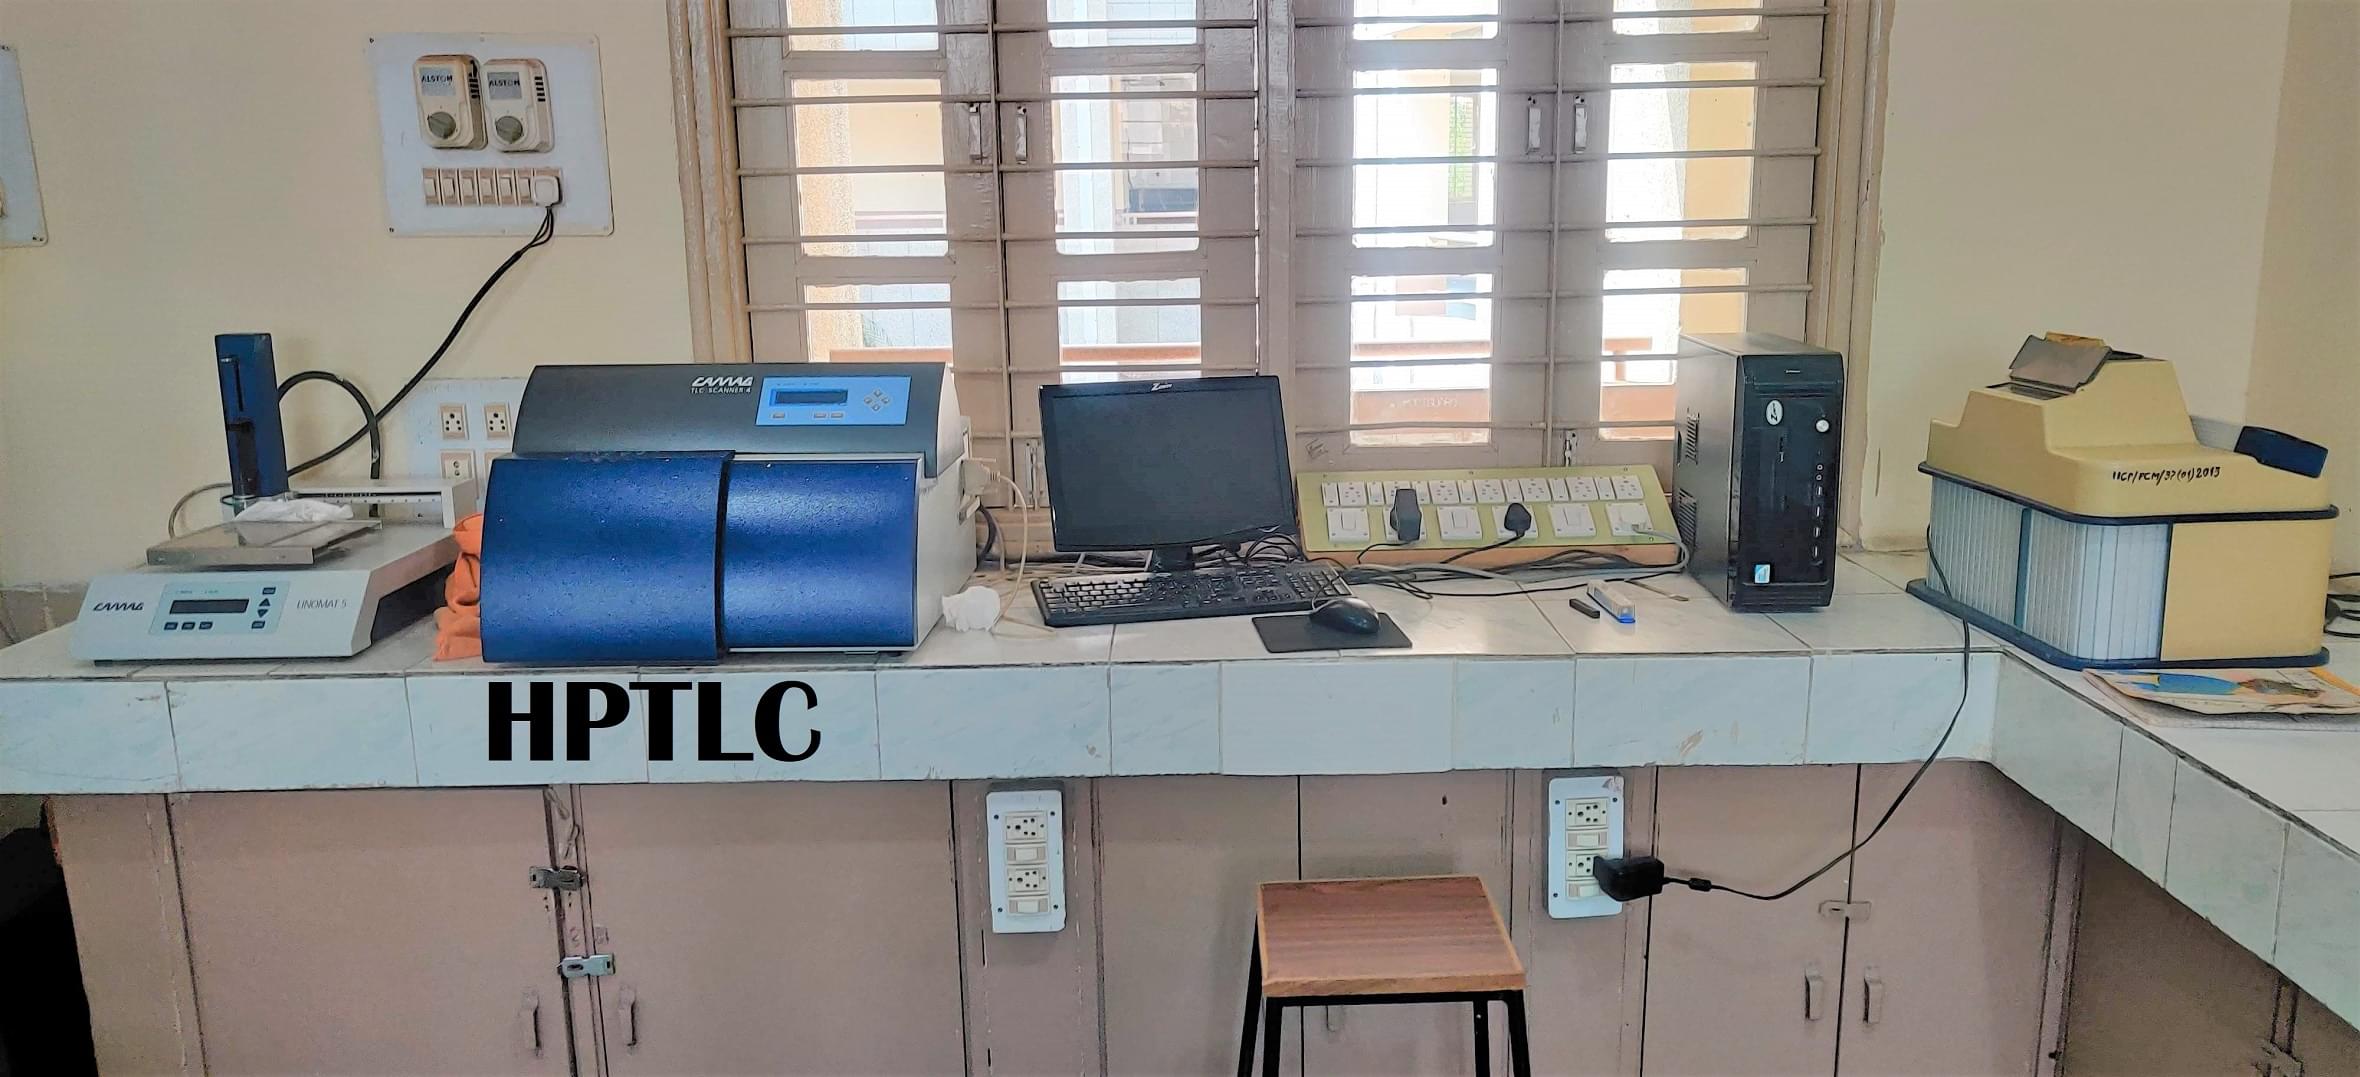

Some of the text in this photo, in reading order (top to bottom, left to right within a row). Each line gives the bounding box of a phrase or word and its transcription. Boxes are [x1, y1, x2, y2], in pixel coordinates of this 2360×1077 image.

[421, 74, 453, 83] ALSTOM
[488, 79, 521, 88] ALSTOM
[691, 376, 754, 387] CAMAG
[93, 602, 145, 611] CAMAG
[296, 599, 340, 609] LINOMAT
